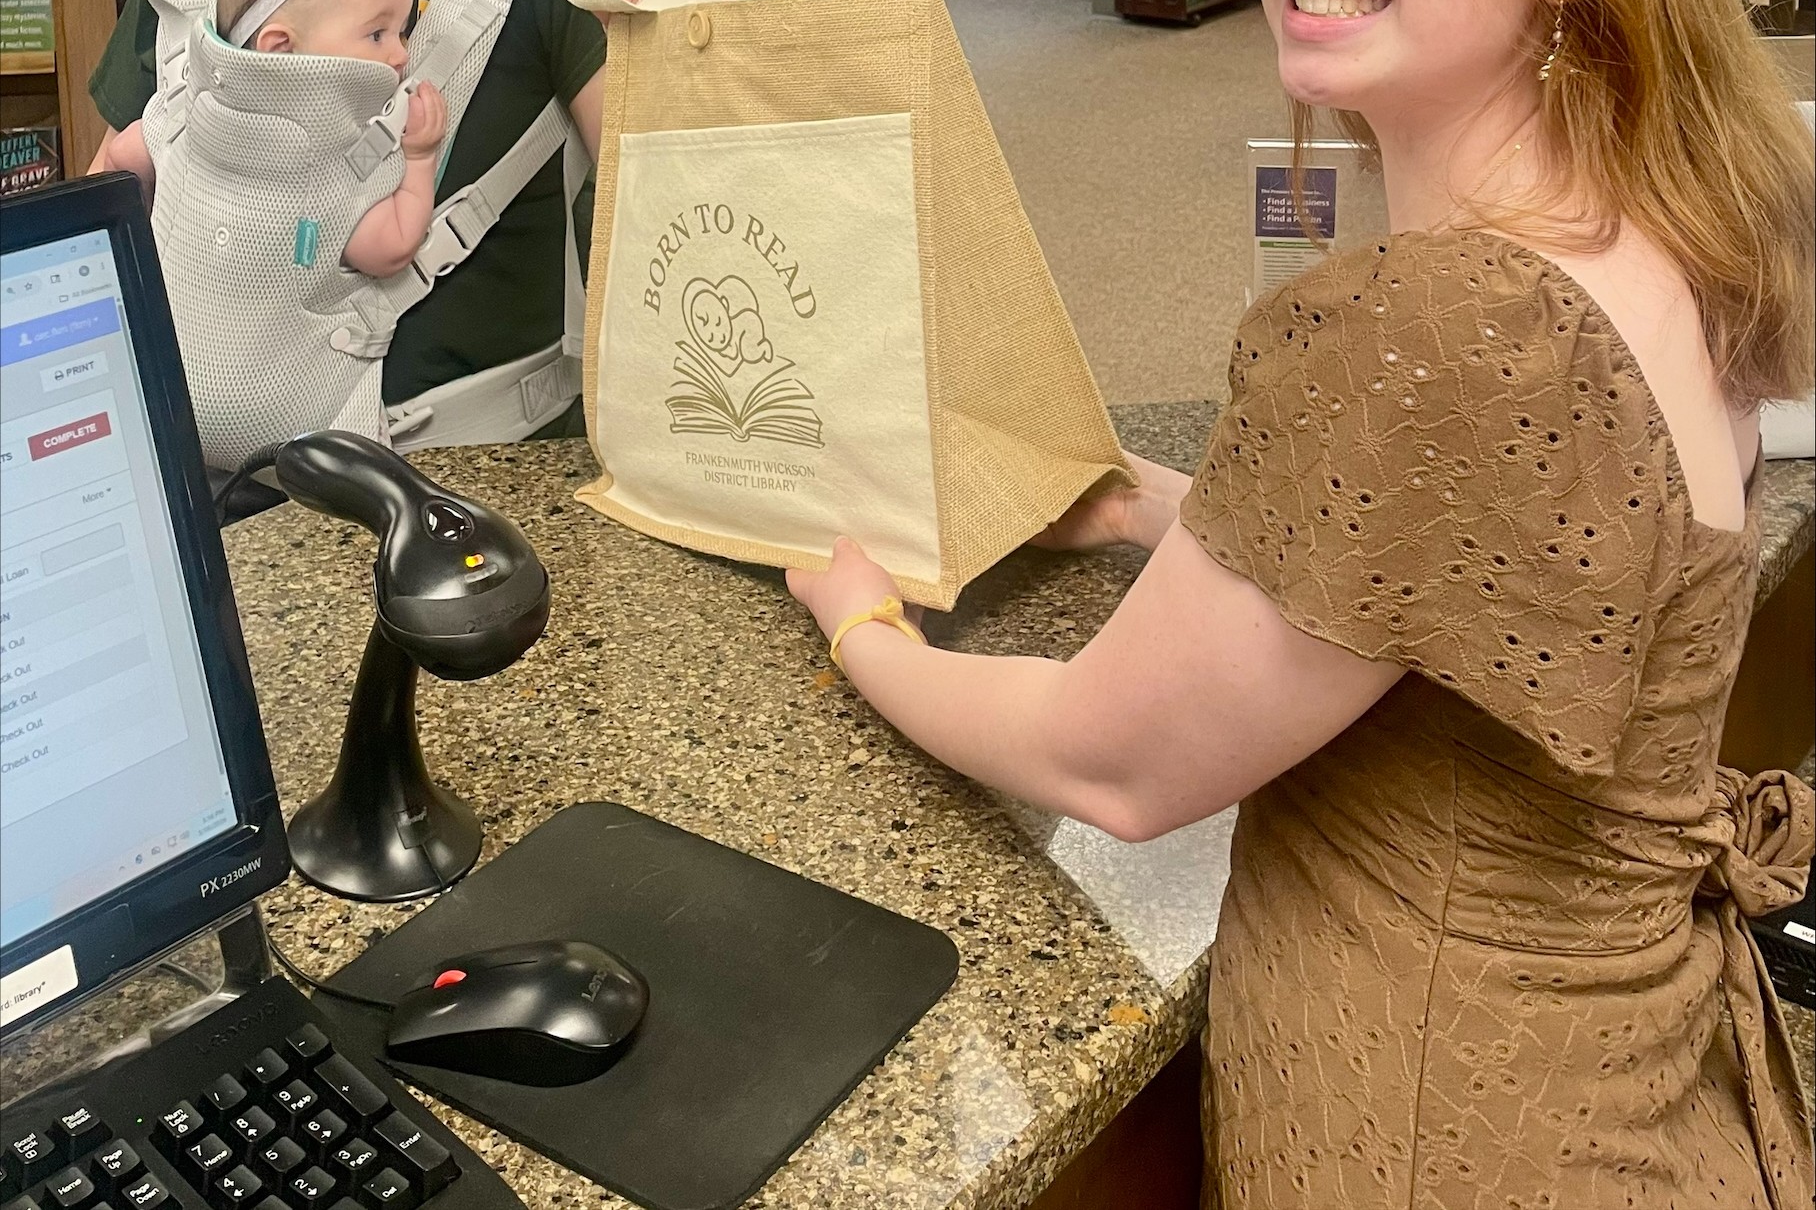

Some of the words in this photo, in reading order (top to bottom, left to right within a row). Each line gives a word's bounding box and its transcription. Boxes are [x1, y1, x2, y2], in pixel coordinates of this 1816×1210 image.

[1, 132, 38, 154] EFFERY
[1267, 198, 1286, 206] Find
[1294, 198, 1330, 206] siness
[1267, 206, 1286, 214] Find
[1267, 215, 1286, 223] Find
[644, 212, 691, 316] BORN
[694, 203, 735, 234] TO
[742, 213, 817, 320] READ
[66, 361, 95, 377] PRINT
[43, 423, 97, 449] COMPLETE
[685, 452, 761, 474] FRANKENMUTH
[763, 461, 816, 478] WICKSON
[704, 470, 749, 488] DISTRICT
[751, 476, 797, 492] LIBRARY
[82, 491, 105, 504] More
[6, 568, 29, 582] Loan
[8, 636, 25, 649] Out
[14, 664, 31, 677] Out
[1, 700, 18, 713] eck
[20, 691, 37, 704] Out
[26, 718, 43, 732] Out
[1, 755, 31, 773] Check
[32, 745, 49, 759] Out
[200, 877, 220, 898] PX
[221, 857, 262, 888] 2230MW
[279, 1090, 291, 1102] 9
[236, 1118, 249, 1129] 8
[400, 1131, 421, 1149] Enter
[102, 1149, 123, 1164] Page
[191, 1144, 202, 1157] 7
[265, 1149, 279, 1161] 5
[338, 1150, 351, 1160] 3
[204, 1149, 228, 1167] Home
[58, 1178, 82, 1196] Home
[223, 1177, 235, 1188] 4
[295, 1178, 309, 1190] 2
[130, 1183, 150, 1198] Page
[136, 1188, 160, 1204] Down
